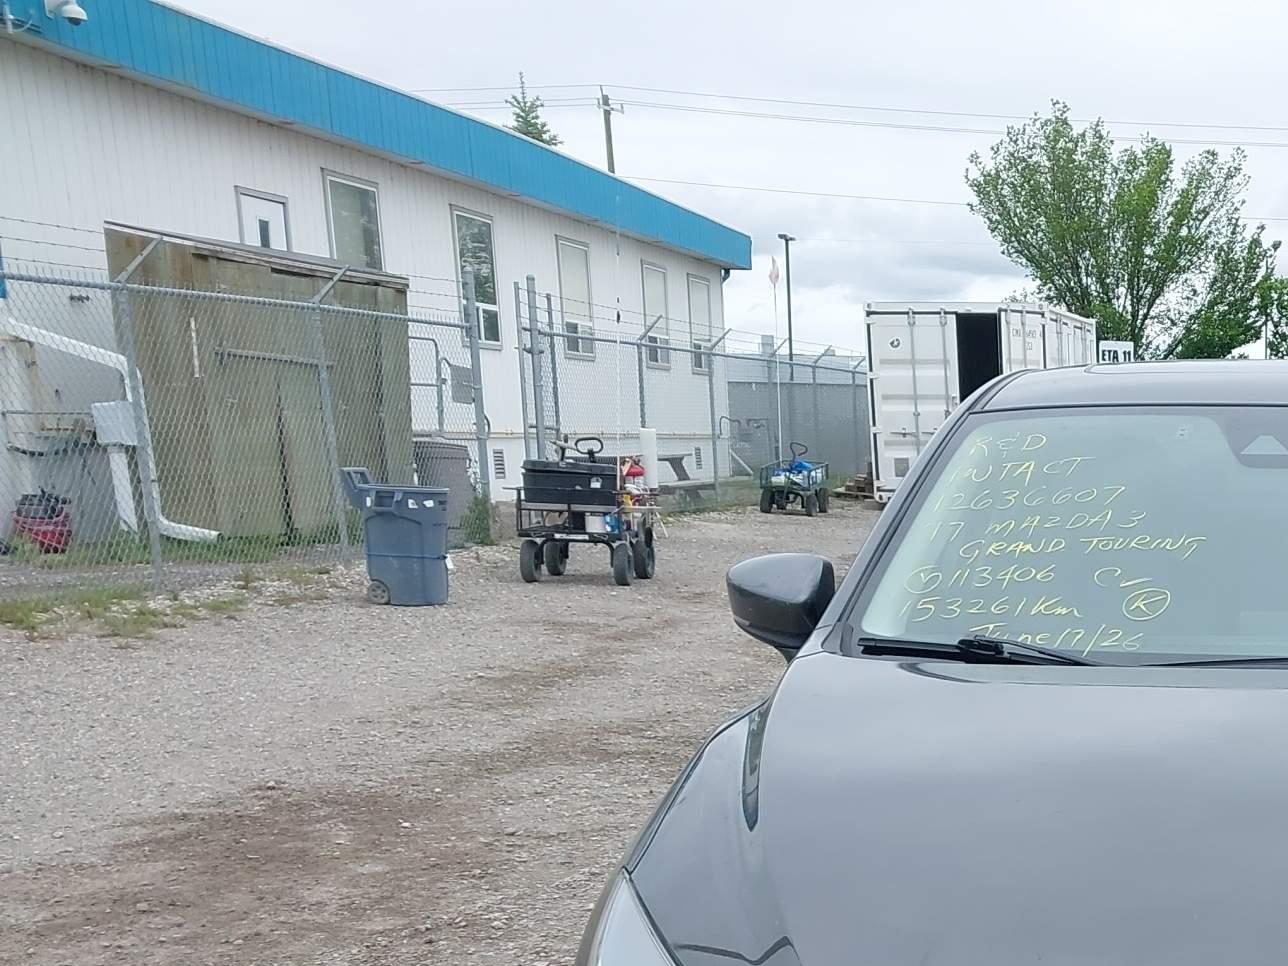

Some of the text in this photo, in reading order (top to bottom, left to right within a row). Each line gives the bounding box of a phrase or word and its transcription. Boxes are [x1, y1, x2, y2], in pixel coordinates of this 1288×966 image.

[1101, 349, 1132, 363] ETA 11
[934, 485, 1126, 512] 12636607
[959, 533, 1208, 565] GRAND TOURING
